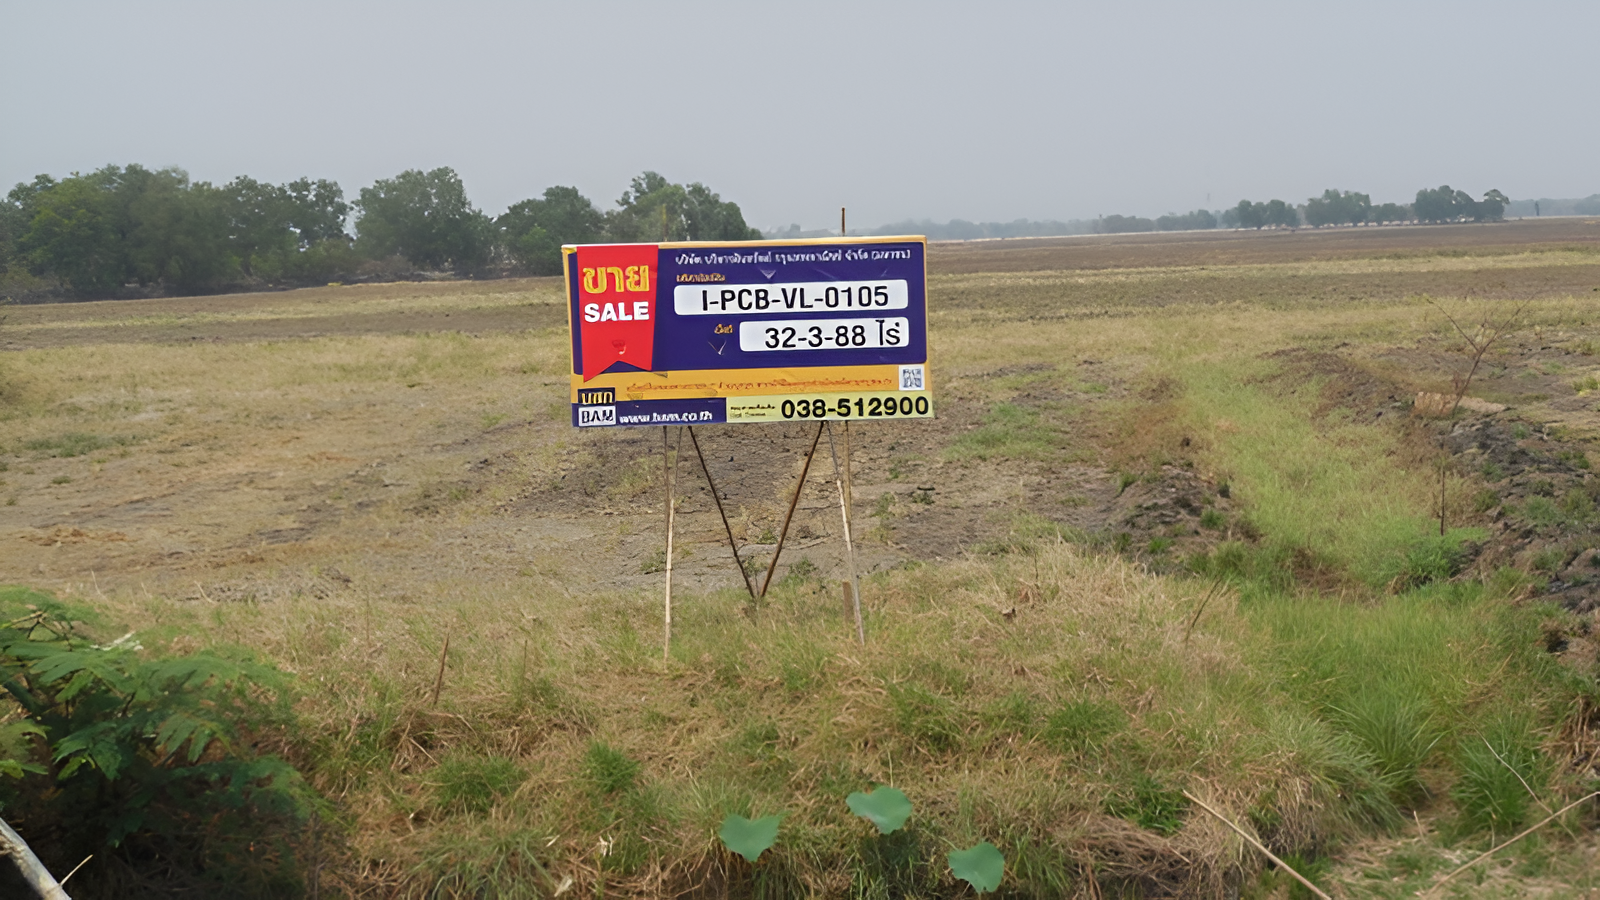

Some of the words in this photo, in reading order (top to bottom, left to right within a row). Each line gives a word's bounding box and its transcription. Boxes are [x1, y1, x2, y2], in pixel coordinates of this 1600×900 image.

[582, 265, 650, 294] ขาย
[702, 285, 889, 311] I-PCB-VL-0105
[584, 301, 650, 323] SALE
[765, 325, 866, 348] 32-3-88
[874, 319, 901, 346] ไร่
[781, 396, 929, 419] 038-512900
